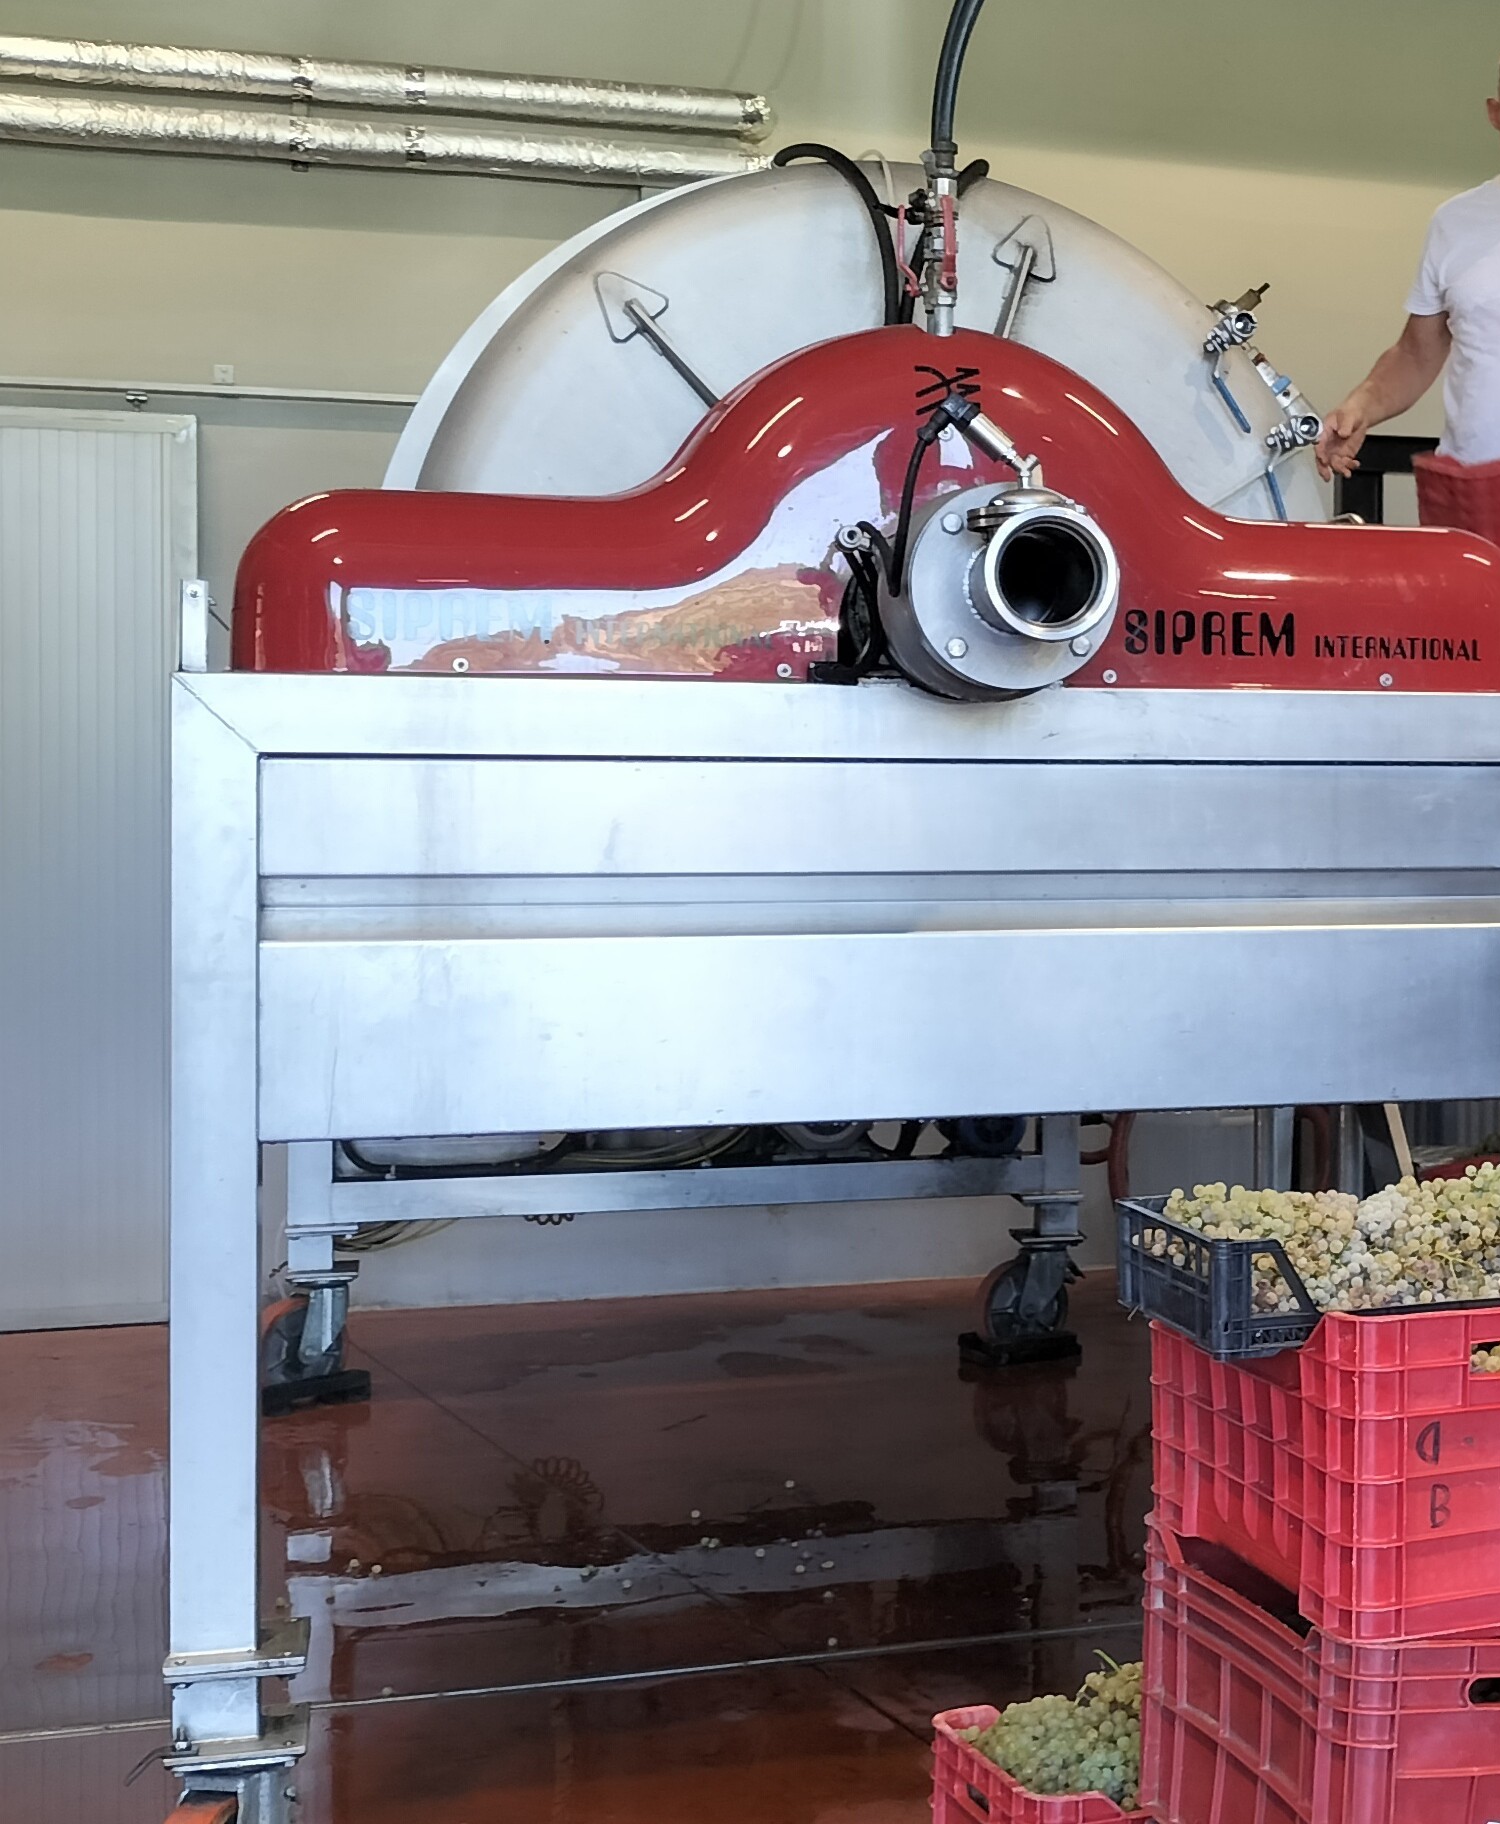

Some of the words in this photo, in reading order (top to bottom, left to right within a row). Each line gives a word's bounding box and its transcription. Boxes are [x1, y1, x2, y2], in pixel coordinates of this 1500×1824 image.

[347, 590, 552, 643] SIPREM
[1124, 608, 1295, 657] SIPREM
[1314, 634, 1482, 662] INTERNATIONAL
